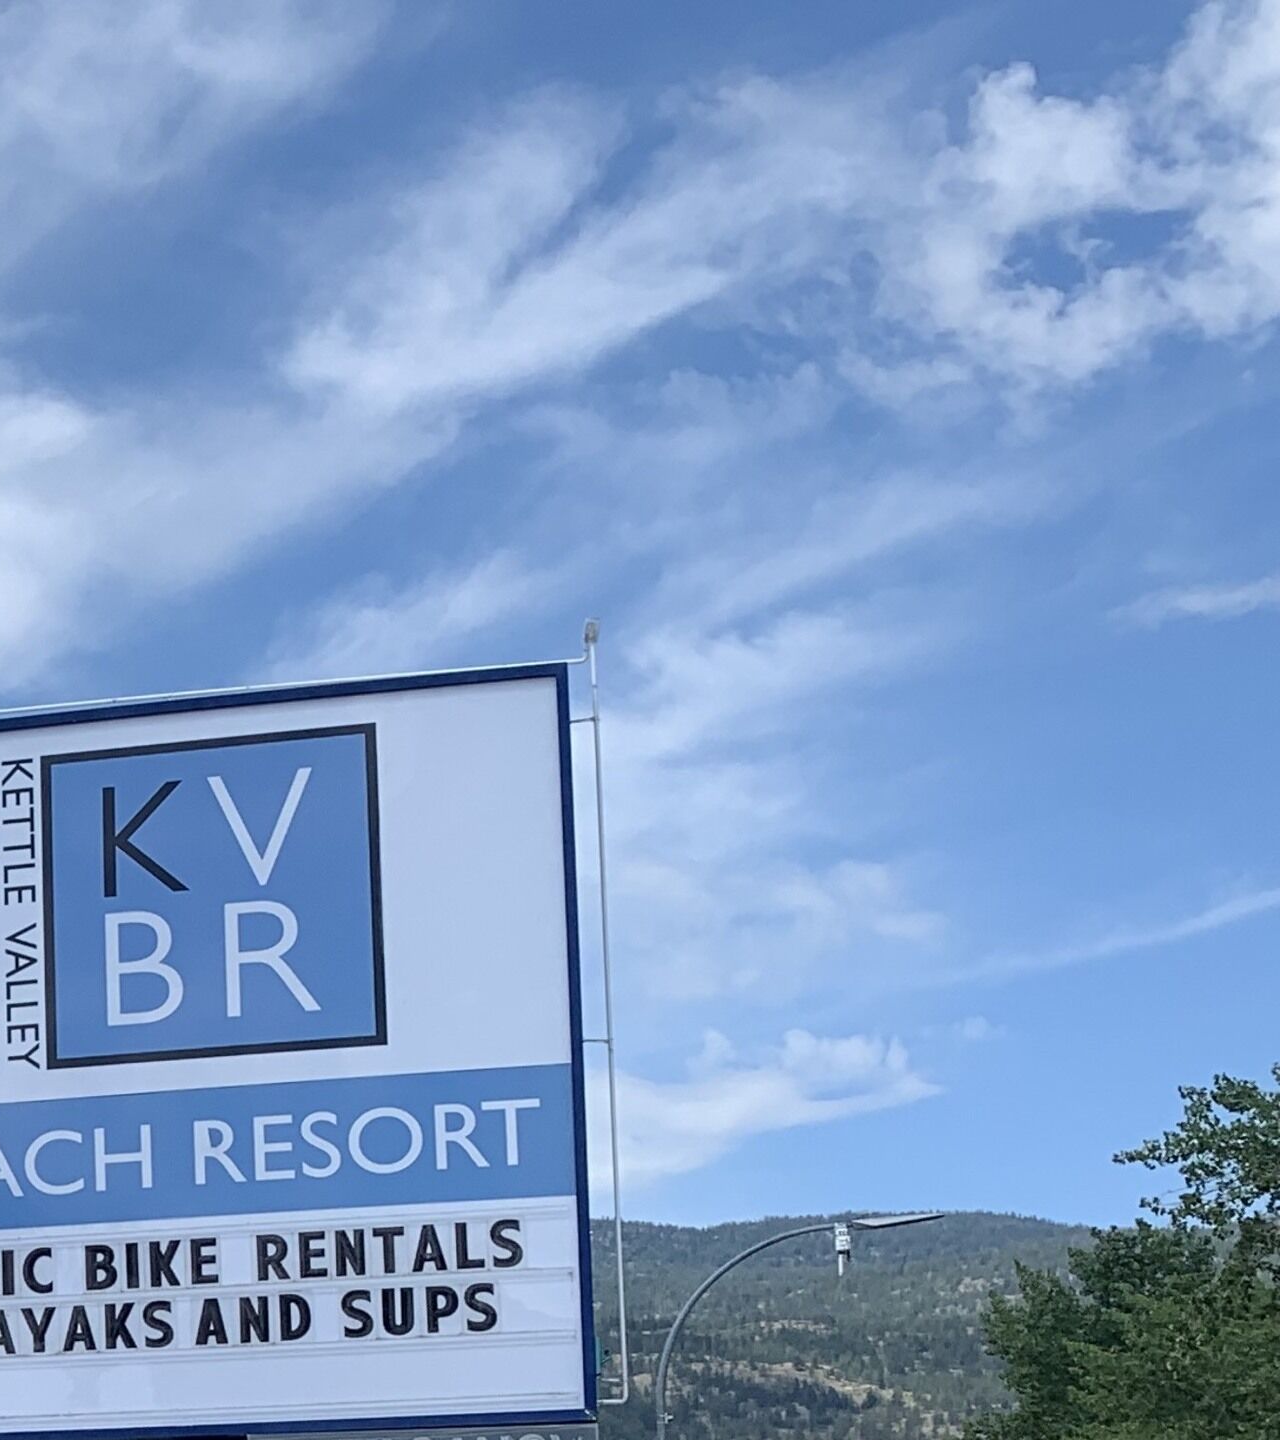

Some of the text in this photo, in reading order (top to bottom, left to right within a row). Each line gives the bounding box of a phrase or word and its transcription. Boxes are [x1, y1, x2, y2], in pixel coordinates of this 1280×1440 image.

[0, 758, 41, 1068] KETTLE VALLEY
[193, 1097, 541, 1185] RESORT
[85, 1236, 220, 1291] BIKE
[256, 1219, 525, 1281] RENTALS
[195, 1293, 312, 1346] AND
[342, 1282, 498, 1336] SUPS
